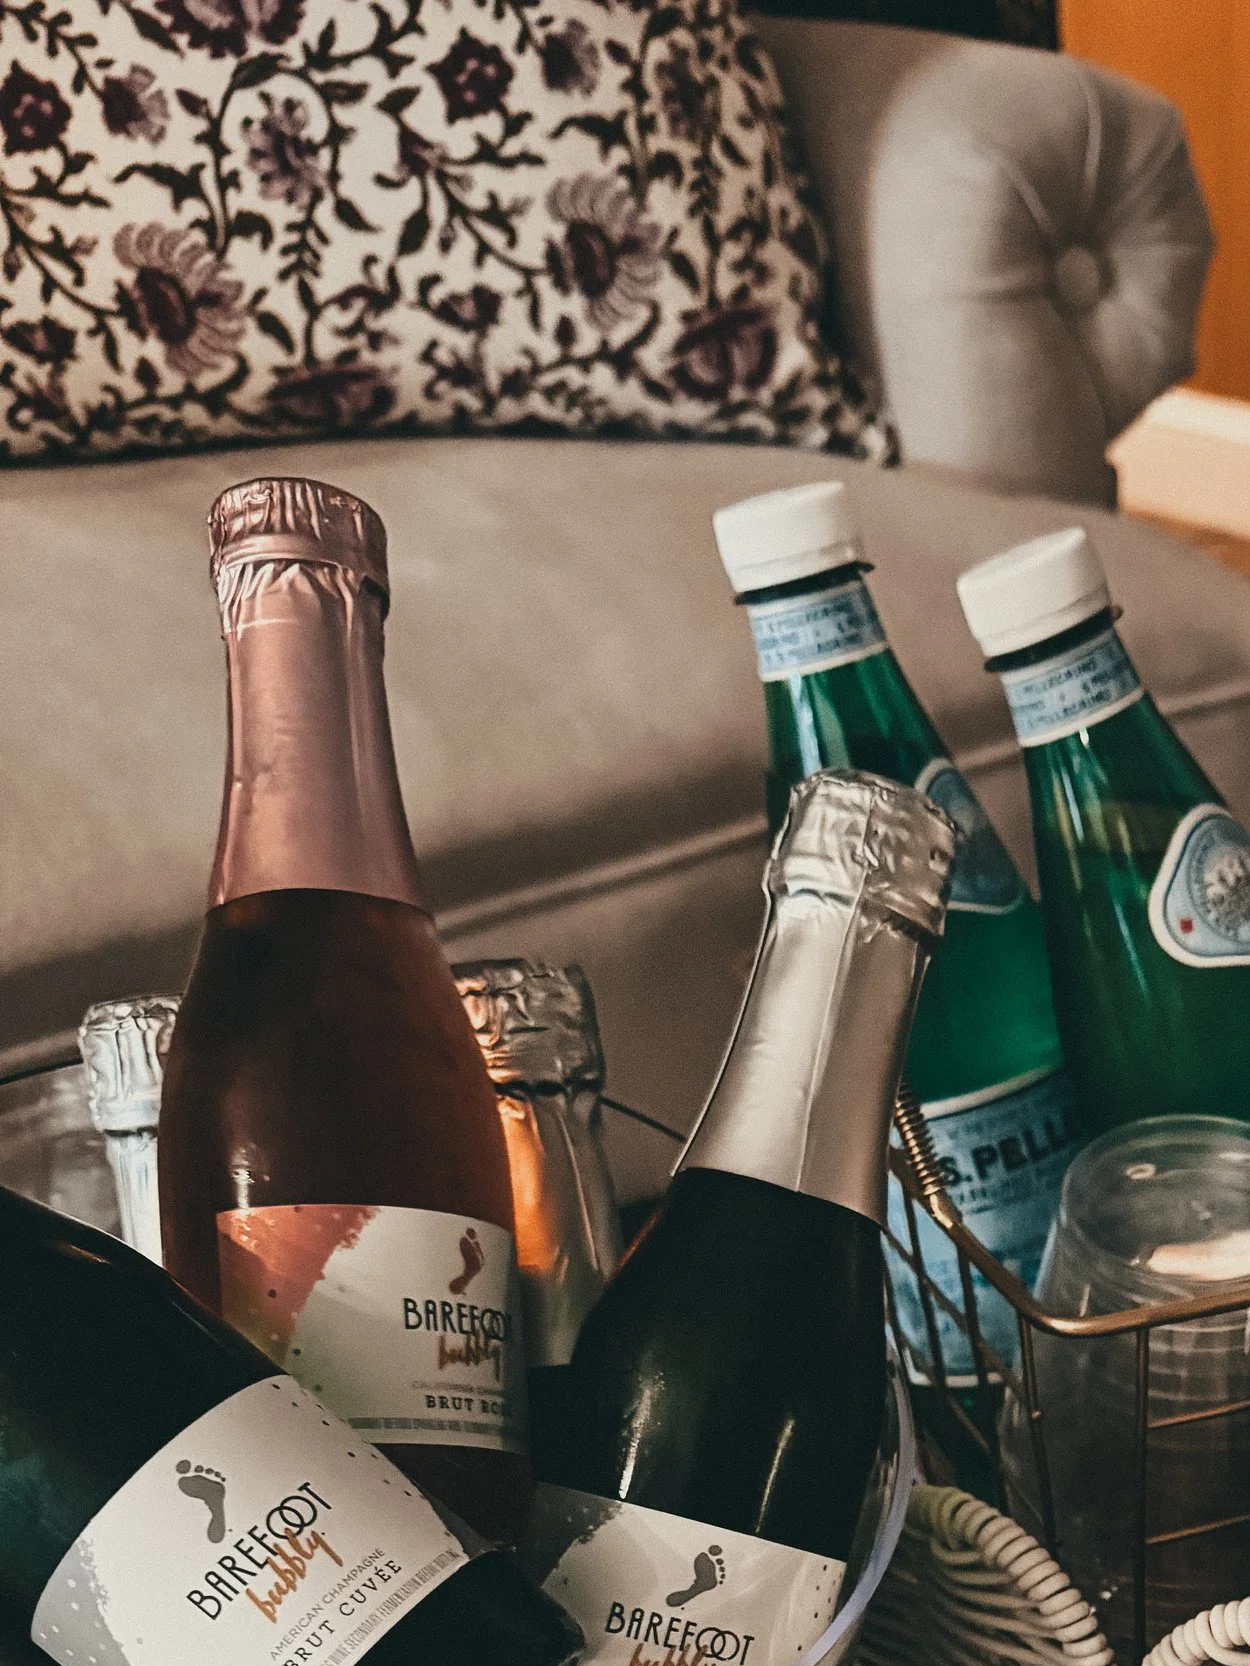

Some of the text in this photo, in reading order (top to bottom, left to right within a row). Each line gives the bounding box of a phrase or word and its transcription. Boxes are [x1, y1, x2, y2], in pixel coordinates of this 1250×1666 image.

[938, 1112, 1072, 1187] S.PELL
[403, 1297, 509, 1343] BAREFOO
[425, 1394, 475, 1411] BRUT
[186, 1481, 332, 1621] BAREFOOT
[245, 1526, 344, 1624] bubbly
[270, 1548, 385, 1661] AMERICAN CHAMPAGNE
[339, 1559, 402, 1617] CUVÉE
[605, 1601, 755, 1666] BAREFOOT
